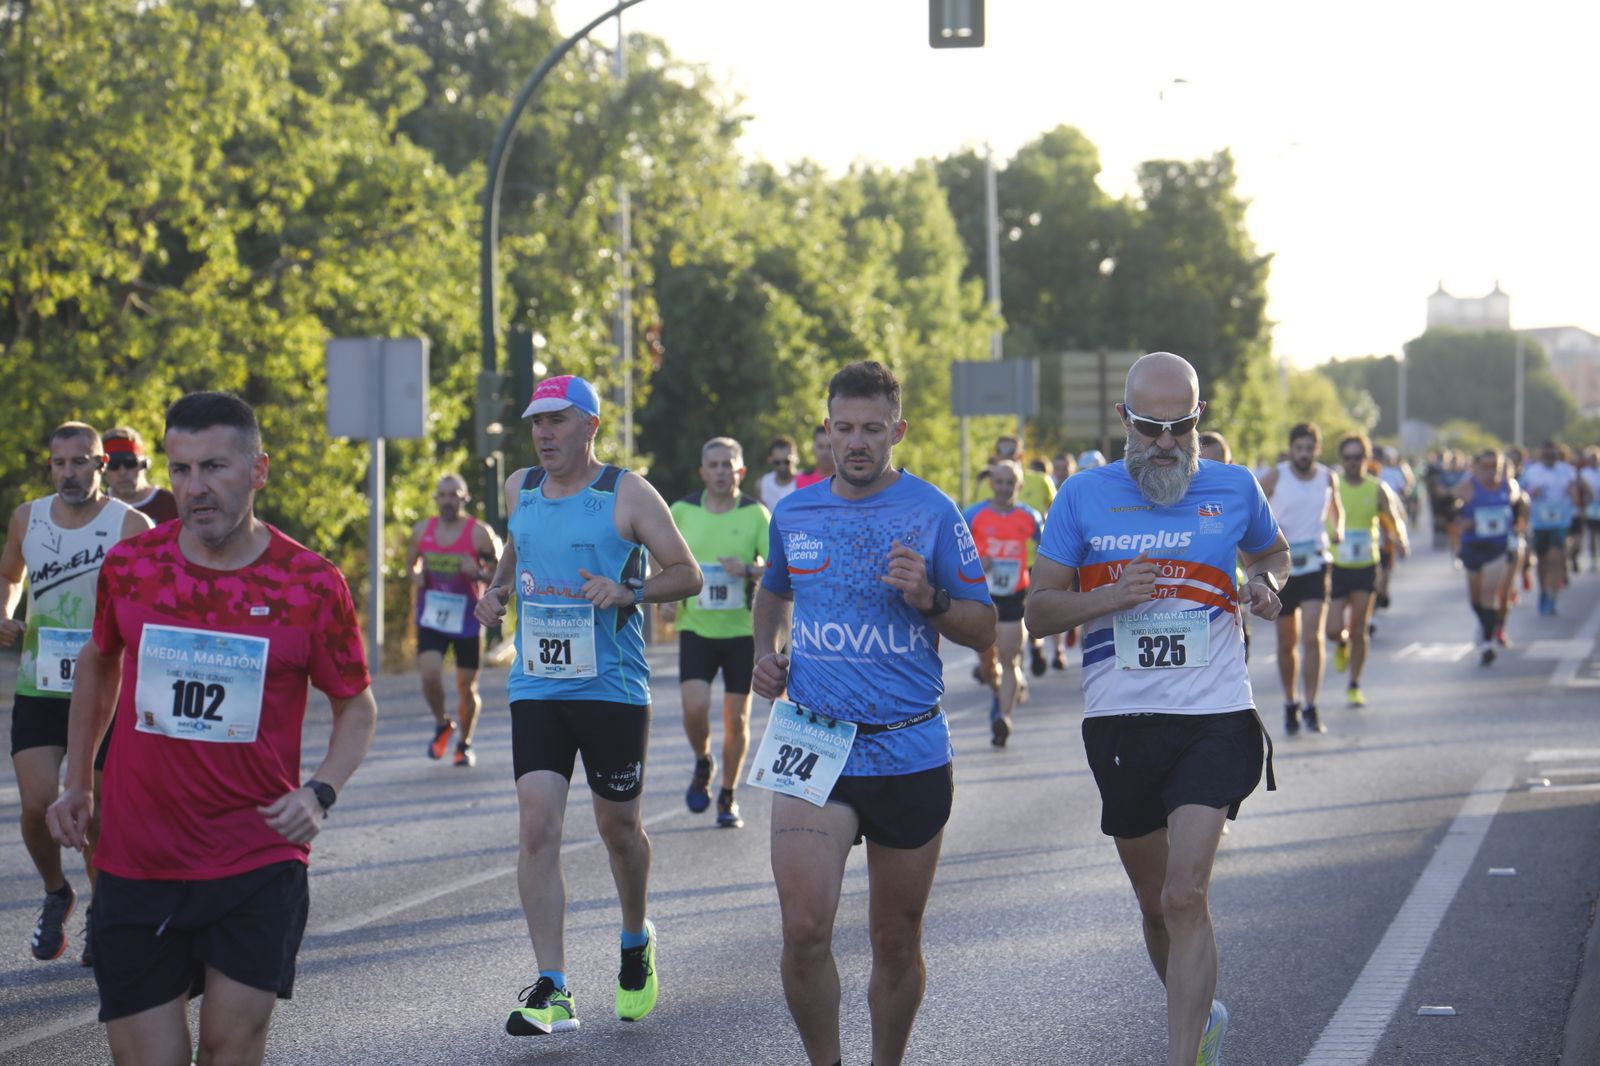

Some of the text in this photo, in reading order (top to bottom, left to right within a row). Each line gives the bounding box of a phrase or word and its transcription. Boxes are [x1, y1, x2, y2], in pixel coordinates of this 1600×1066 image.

[1089, 530, 1192, 553] enerplus
[145, 646, 260, 670] MEDIA MARATÓN
[539, 638, 572, 665] 321
[1138, 635, 1187, 668] 325
[172, 679, 226, 722] 102
[773, 715, 801, 732] MEDIA
[803, 724, 850, 749] MARATÓN
[771, 743, 820, 782] 324
